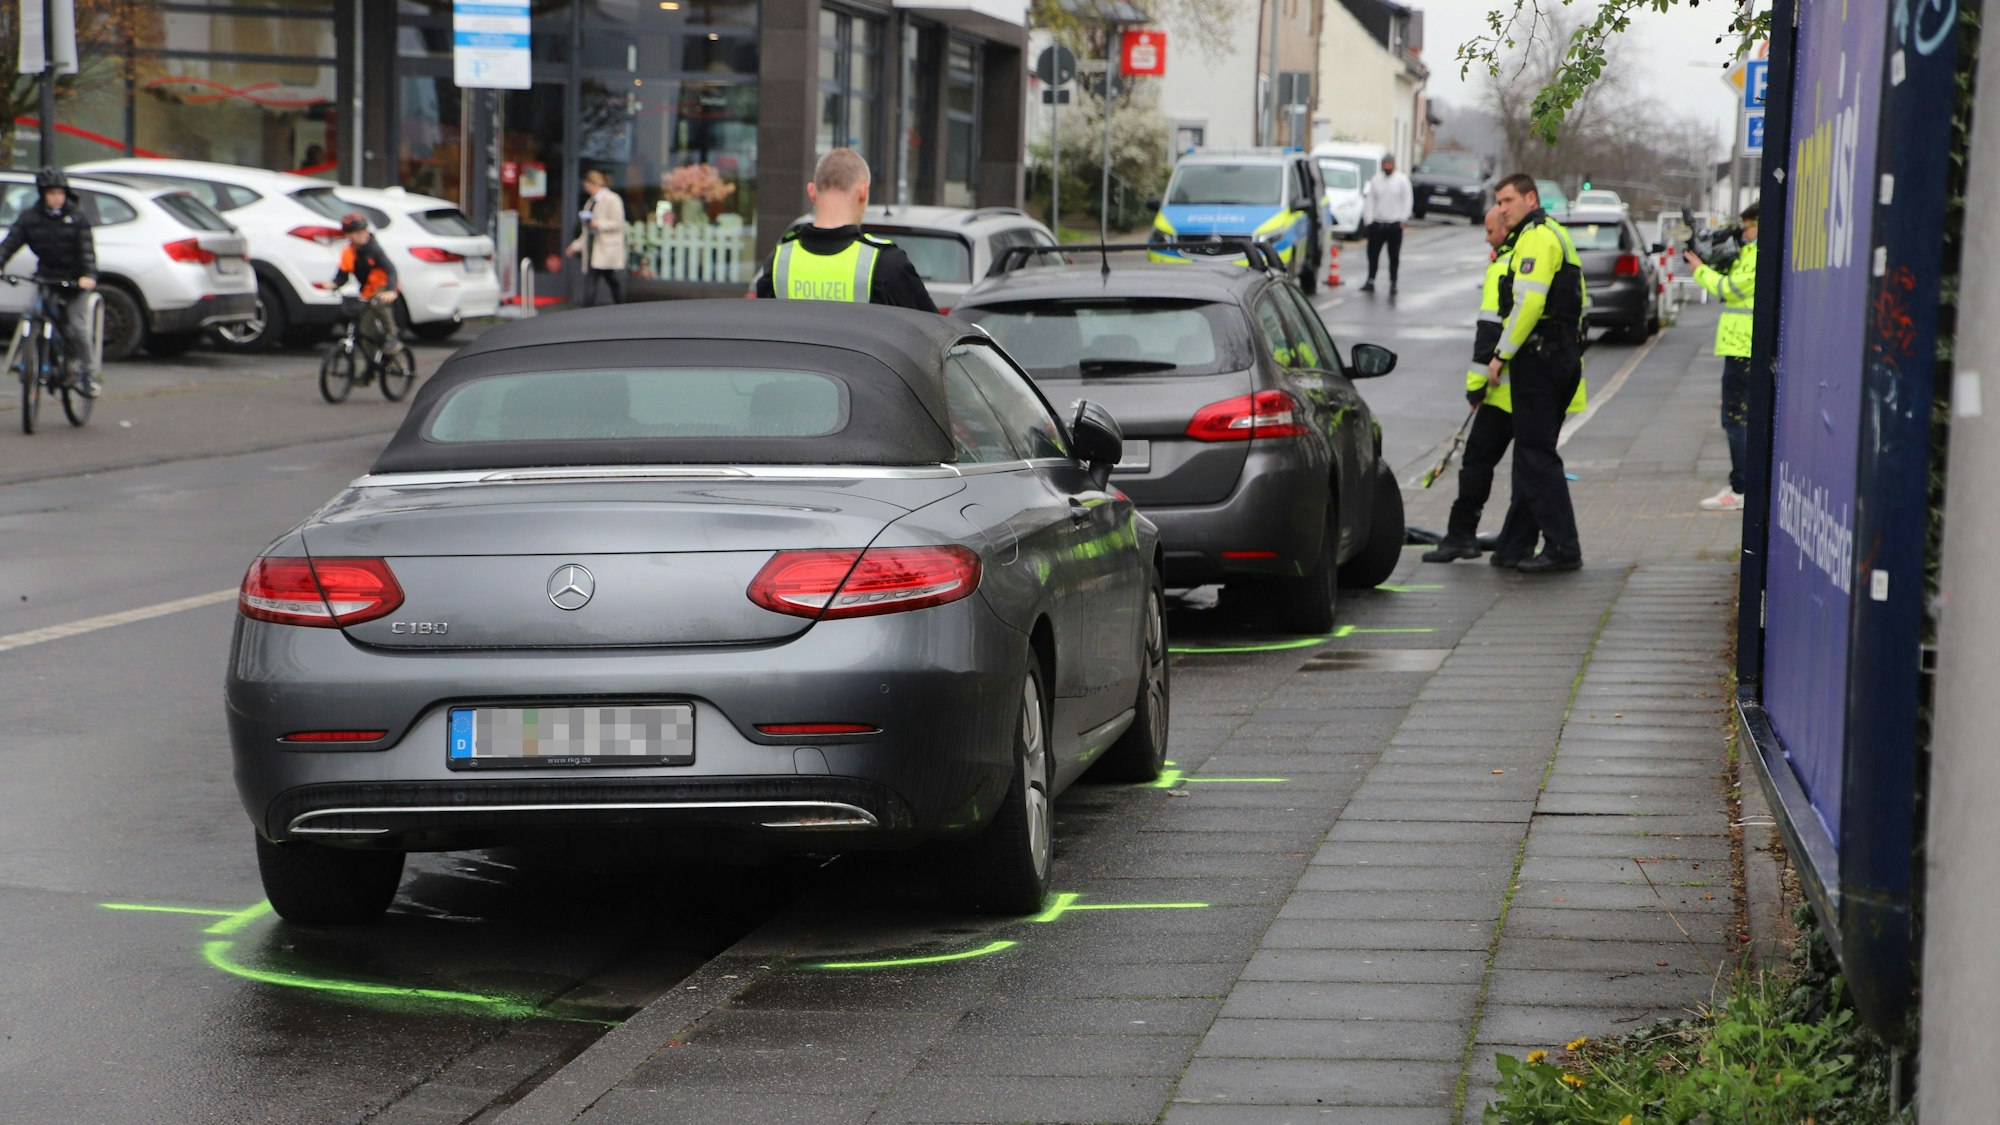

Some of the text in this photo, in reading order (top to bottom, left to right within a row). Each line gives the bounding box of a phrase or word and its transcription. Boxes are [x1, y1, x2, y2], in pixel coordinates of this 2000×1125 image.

[1827, 52, 1860, 269] ist
[1187, 213, 1245, 223] POLIZEI
[794, 280, 847, 300] POLIZEI
[391, 622, 448, 634] C 180
[457, 739, 466, 750] D
[547, 756, 592, 765] www.rkg.de
